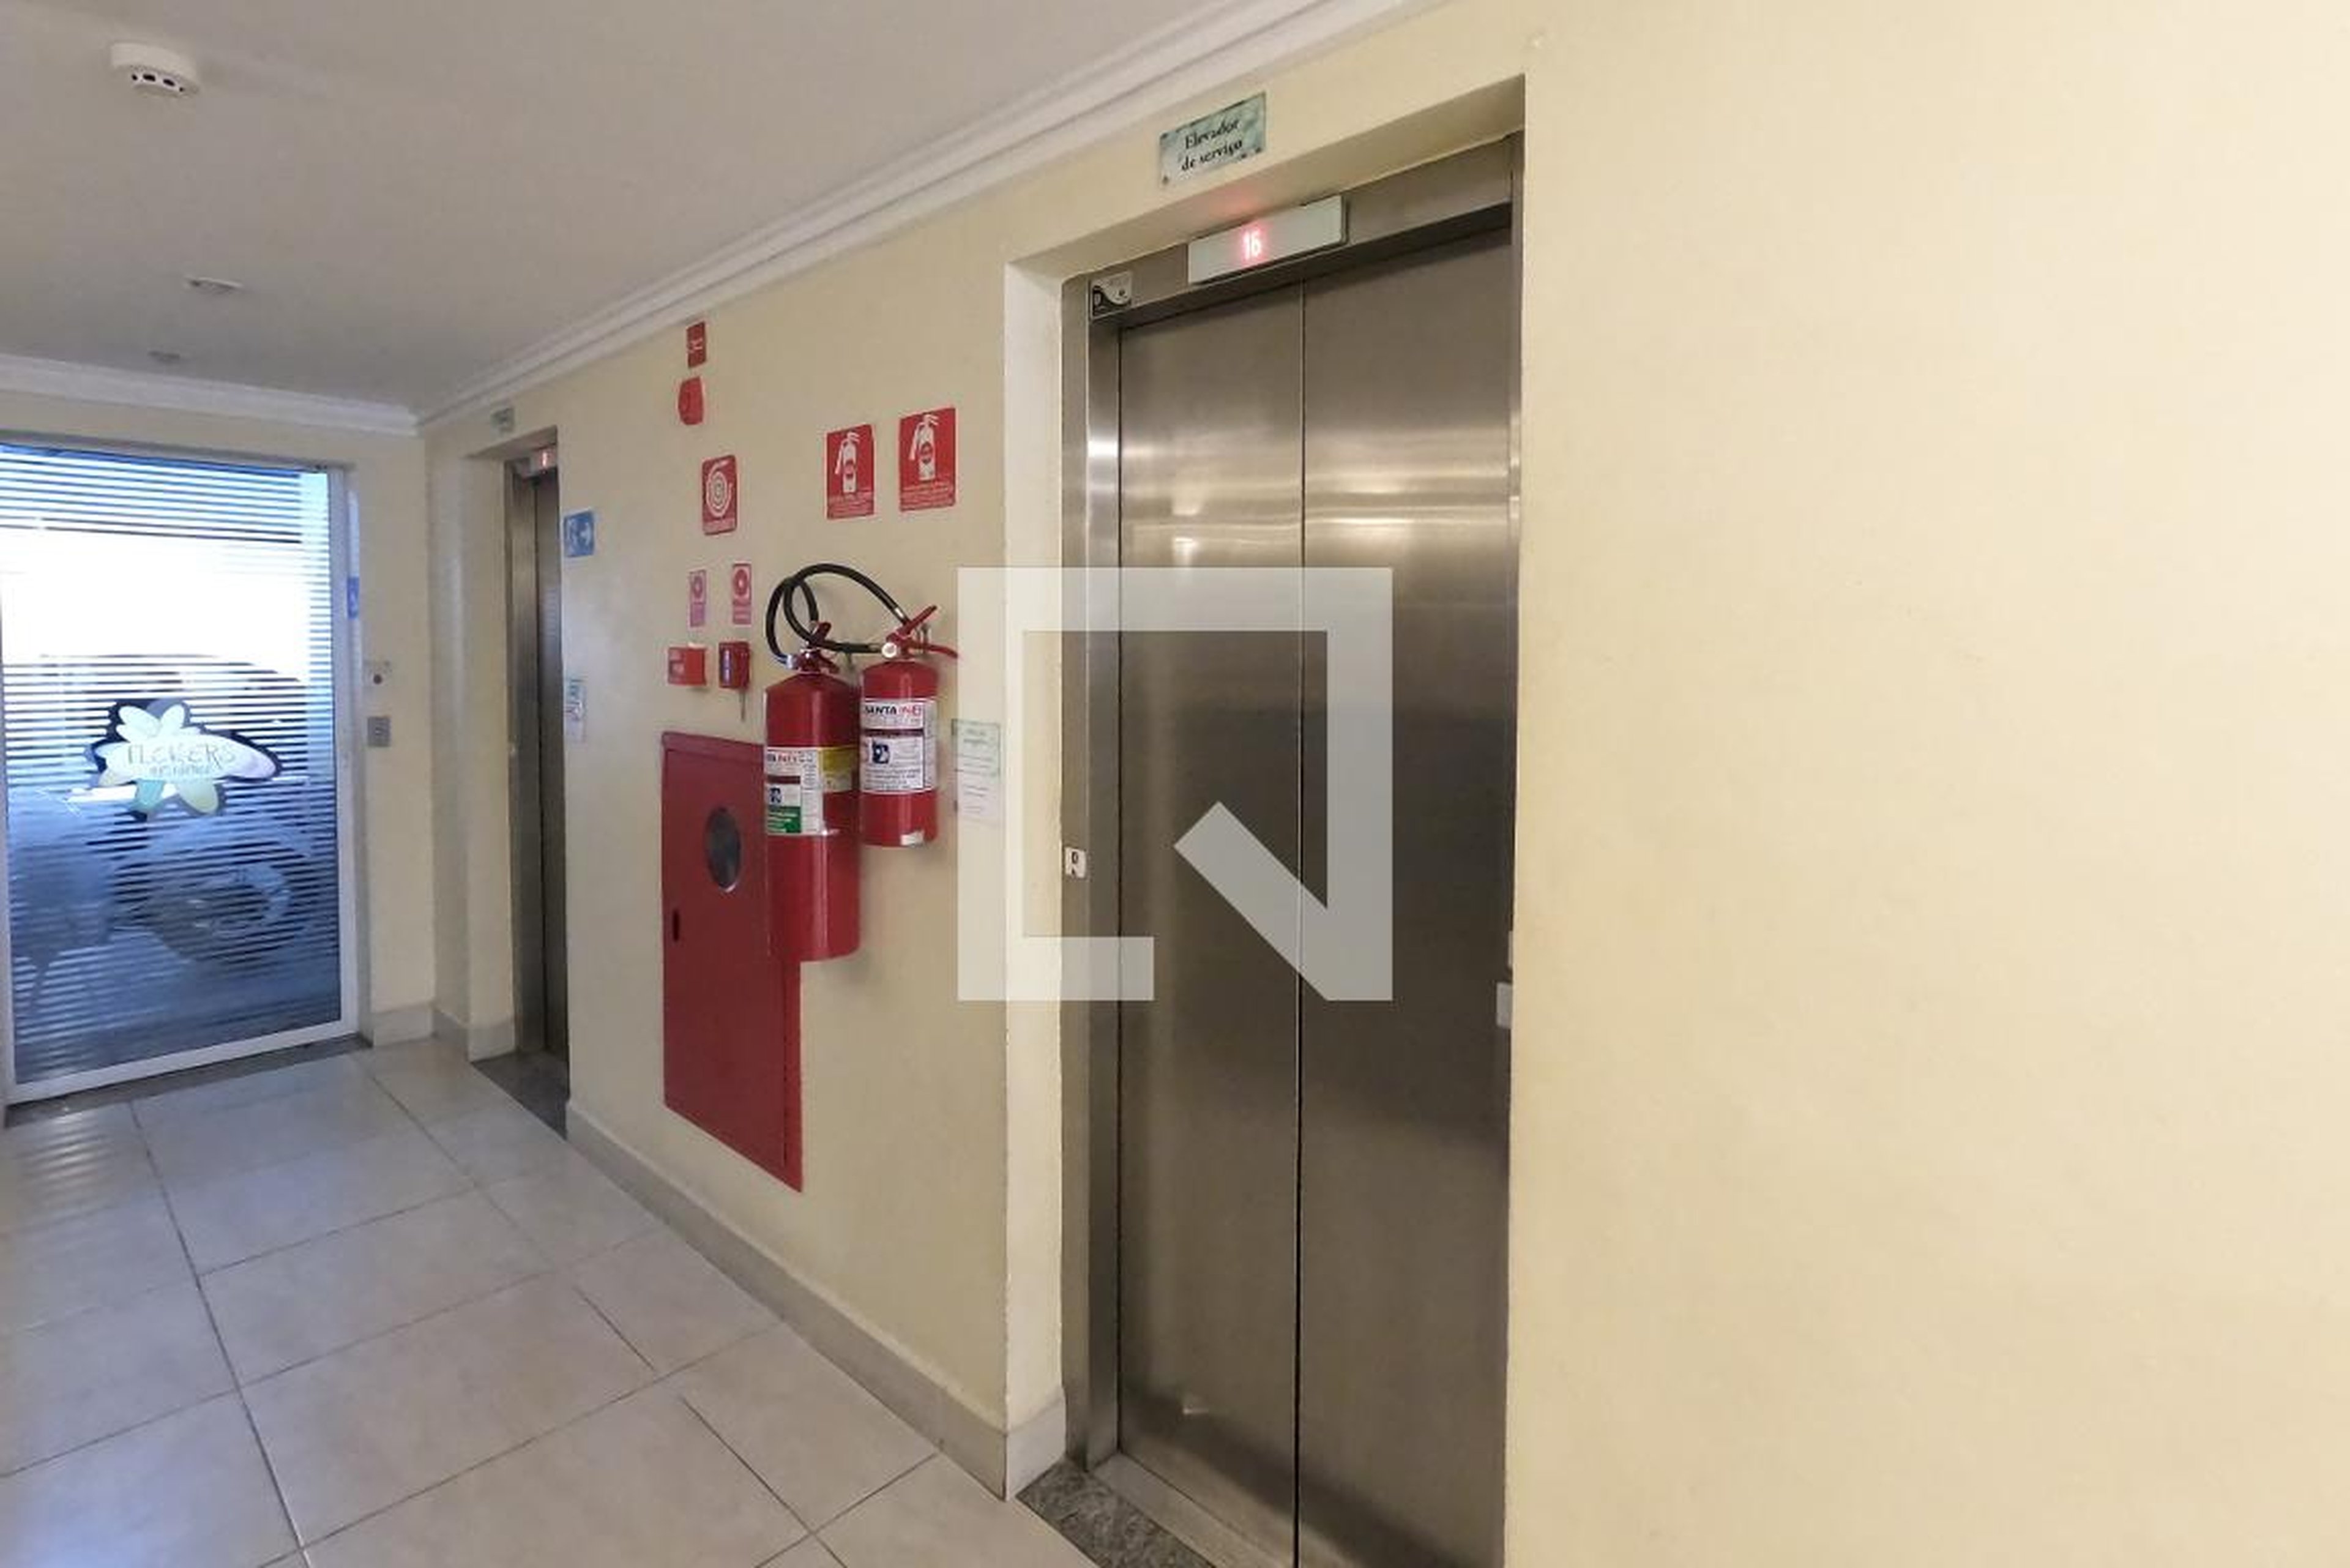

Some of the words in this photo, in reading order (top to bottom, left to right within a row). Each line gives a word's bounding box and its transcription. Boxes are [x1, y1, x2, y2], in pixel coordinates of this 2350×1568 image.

[1185, 119, 1239, 149] Elevador
[1181, 155, 1196, 171] de
[1200, 140, 1242, 163] serviço
[1243, 231, 1262, 259] 16
